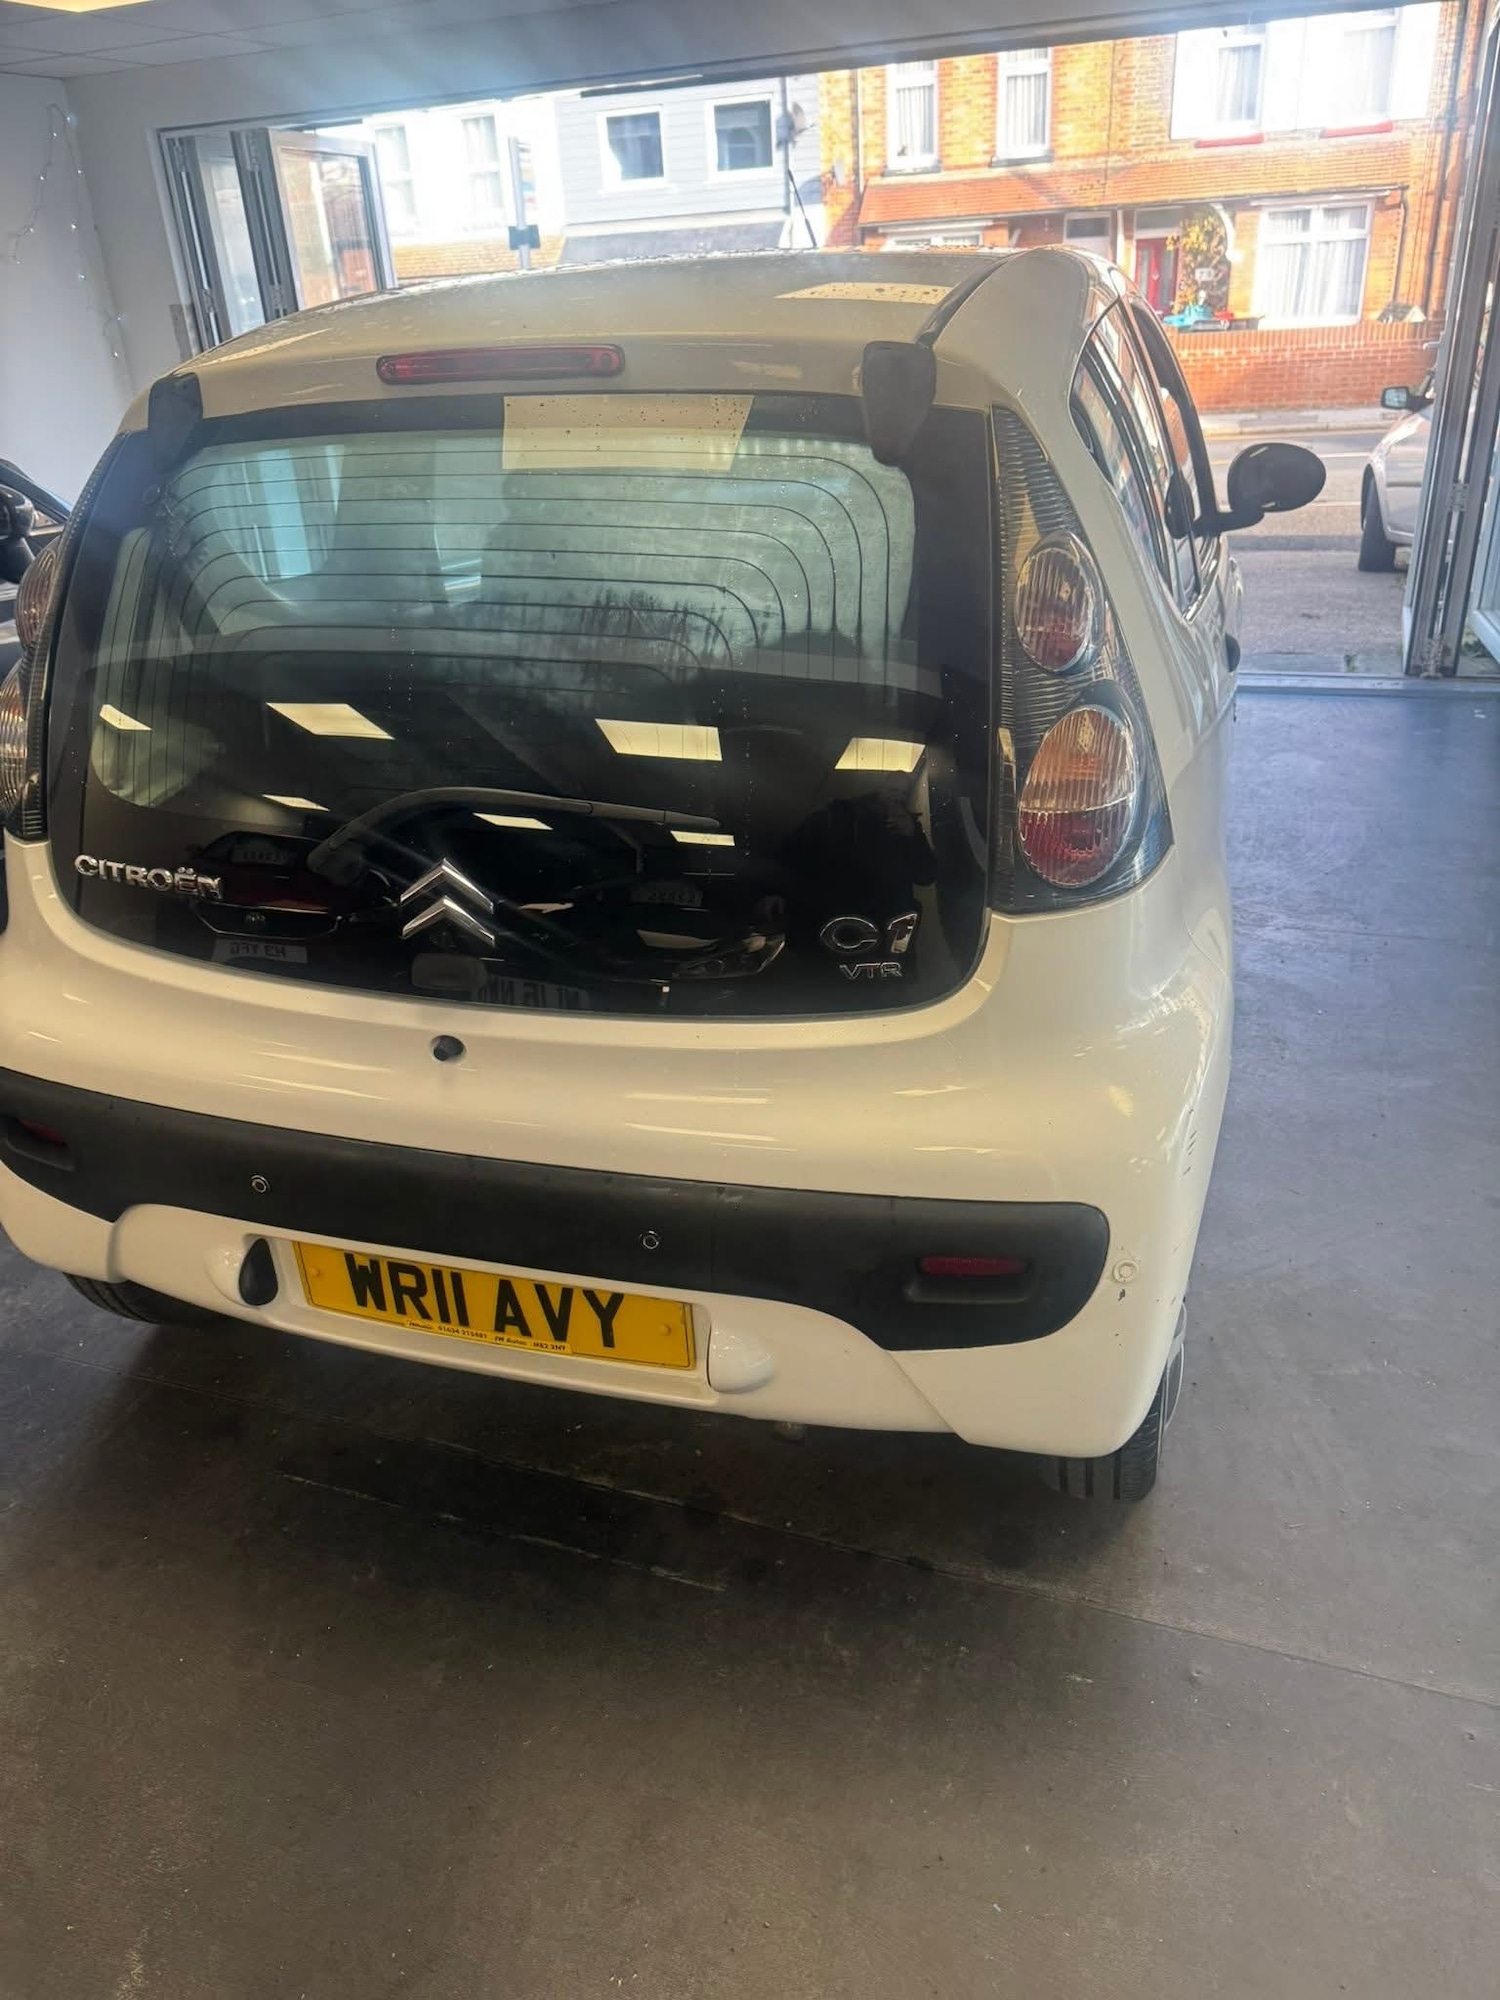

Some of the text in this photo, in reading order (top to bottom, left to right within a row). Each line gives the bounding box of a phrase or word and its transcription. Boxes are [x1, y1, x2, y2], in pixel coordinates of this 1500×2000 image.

[74, 855, 223, 899] CITROËN
[819, 912, 918, 954] C1
[839, 961, 903, 980] VTR
[344, 1252, 625, 1349] WR11 AVY
